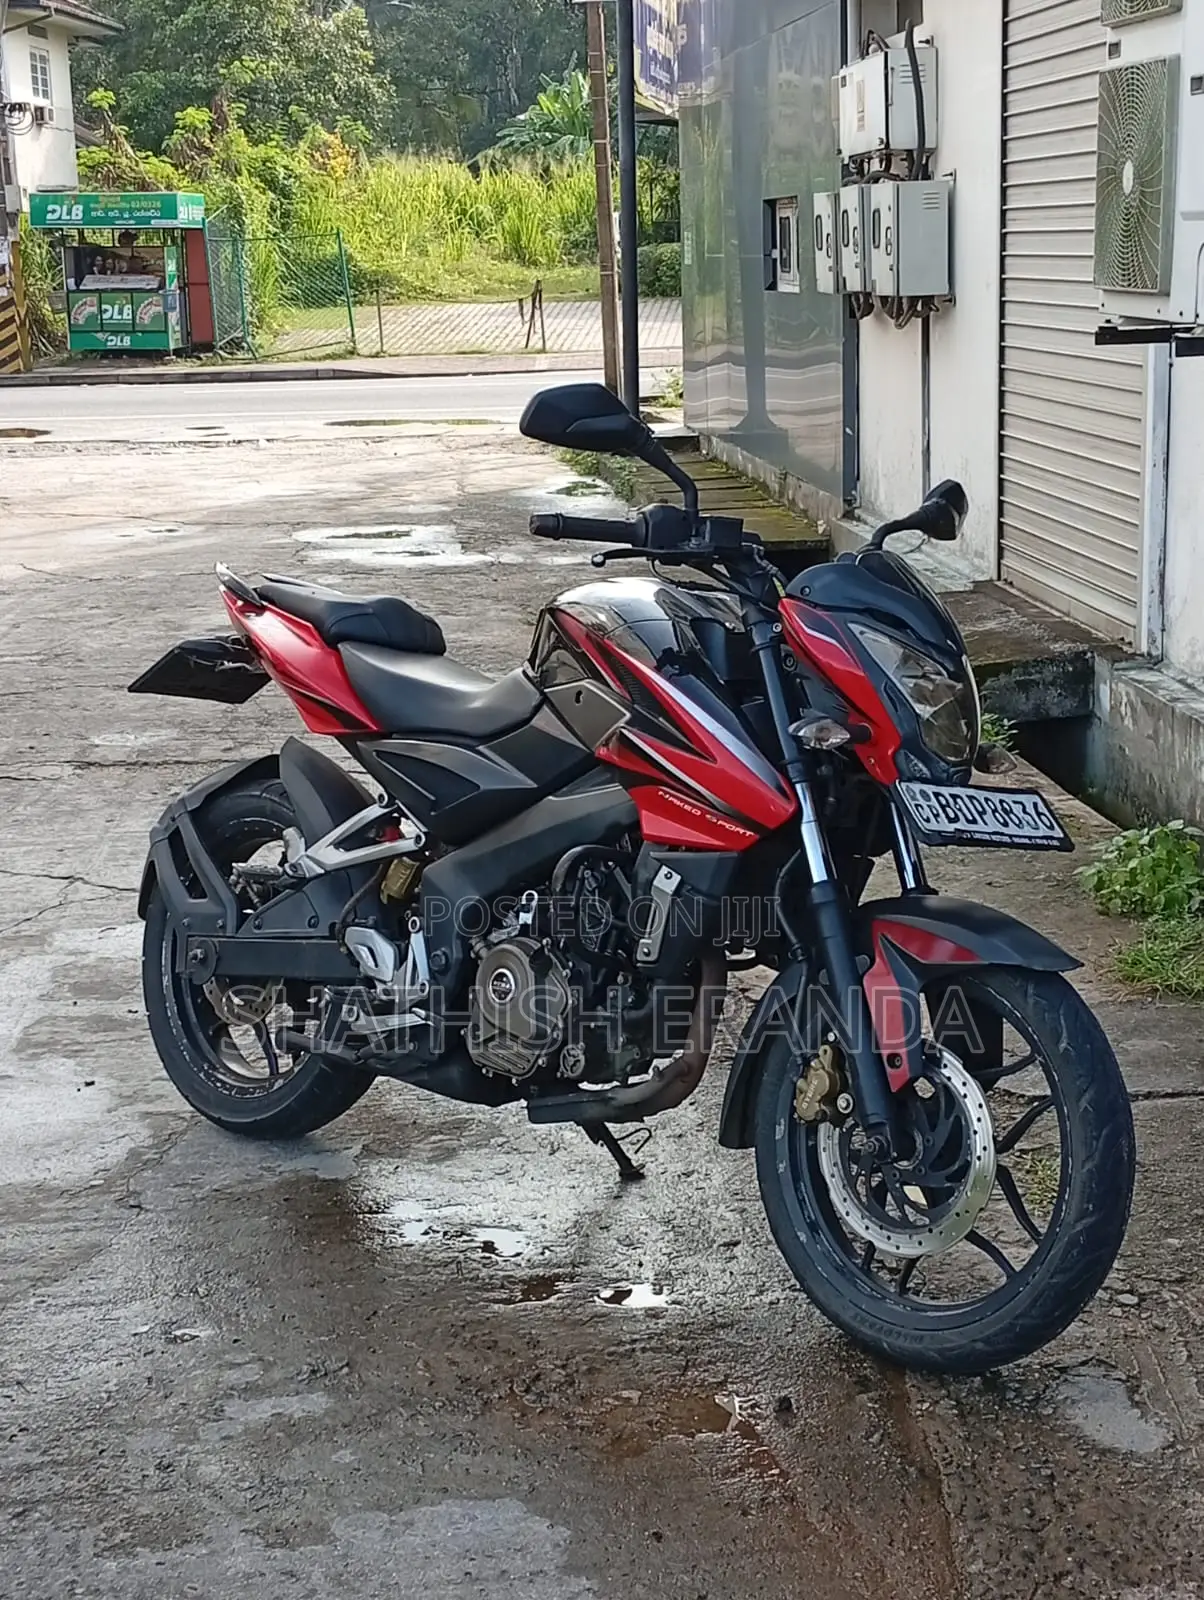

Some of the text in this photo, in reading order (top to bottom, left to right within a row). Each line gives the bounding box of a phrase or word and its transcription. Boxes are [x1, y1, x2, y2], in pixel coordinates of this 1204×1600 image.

[46, 204, 84, 220] DLB
[101, 304, 133, 320] DLB
[107, 335, 131, 346] DLB
[658, 790, 757, 838] NAKED SPORT
[914, 803, 940, 824] CP
